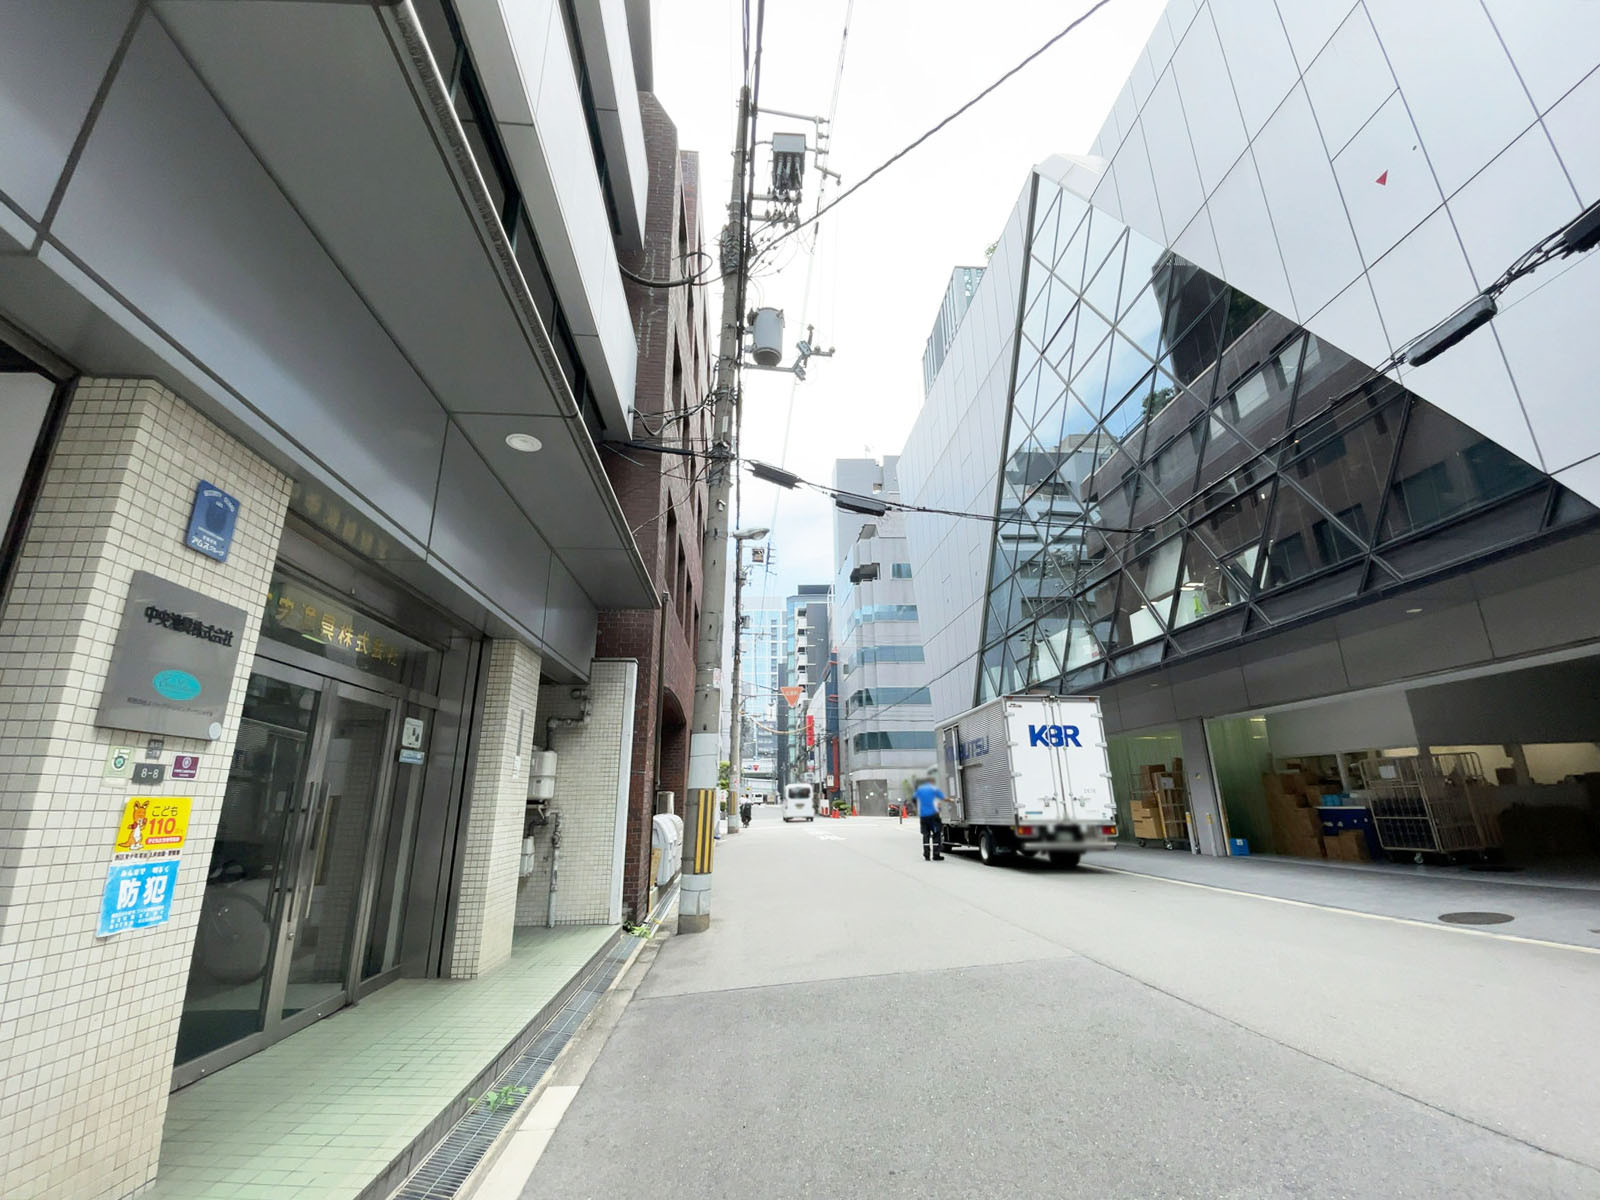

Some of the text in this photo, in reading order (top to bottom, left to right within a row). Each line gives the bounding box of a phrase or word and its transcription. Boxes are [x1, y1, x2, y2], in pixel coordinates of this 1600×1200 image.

[267, 593, 397, 666] 央株式会社
[1029, 725, 1082, 748] KBR
[141, 768, 159, 780] 8-8
[152, 805, 178, 817] こども
[149, 818, 176, 835] 110
[117, 875, 168, 910] 防犯
